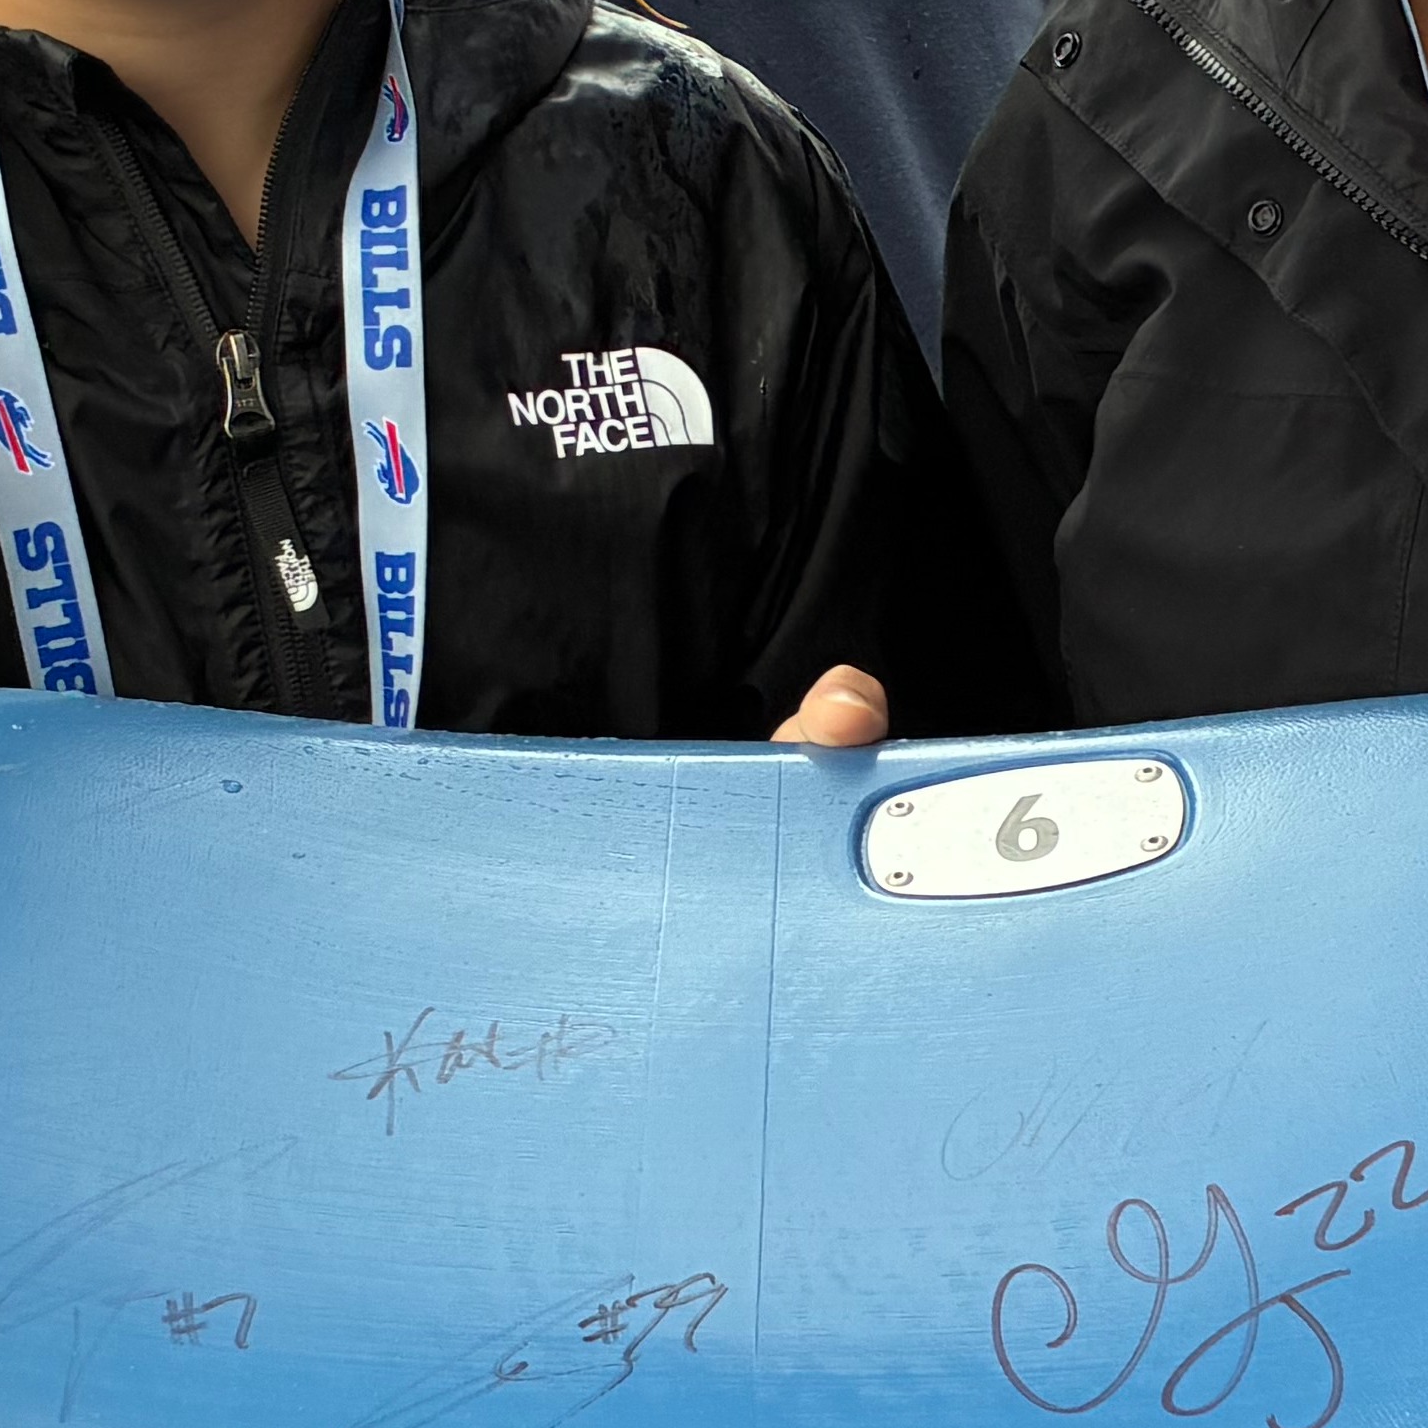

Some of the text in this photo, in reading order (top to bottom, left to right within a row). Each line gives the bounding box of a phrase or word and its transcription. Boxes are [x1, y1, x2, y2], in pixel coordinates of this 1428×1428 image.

[360, 184, 412, 371] BILLS
[561, 348, 638, 388] THE
[507, 381, 647, 426] NORTH
[552, 415, 655, 459] FACE
[13, 521, 98, 696] BILLS
[375, 551, 416, 728] BILLS
[995, 793, 1060, 862] 6
[161, 1290, 257, 1350] #7
